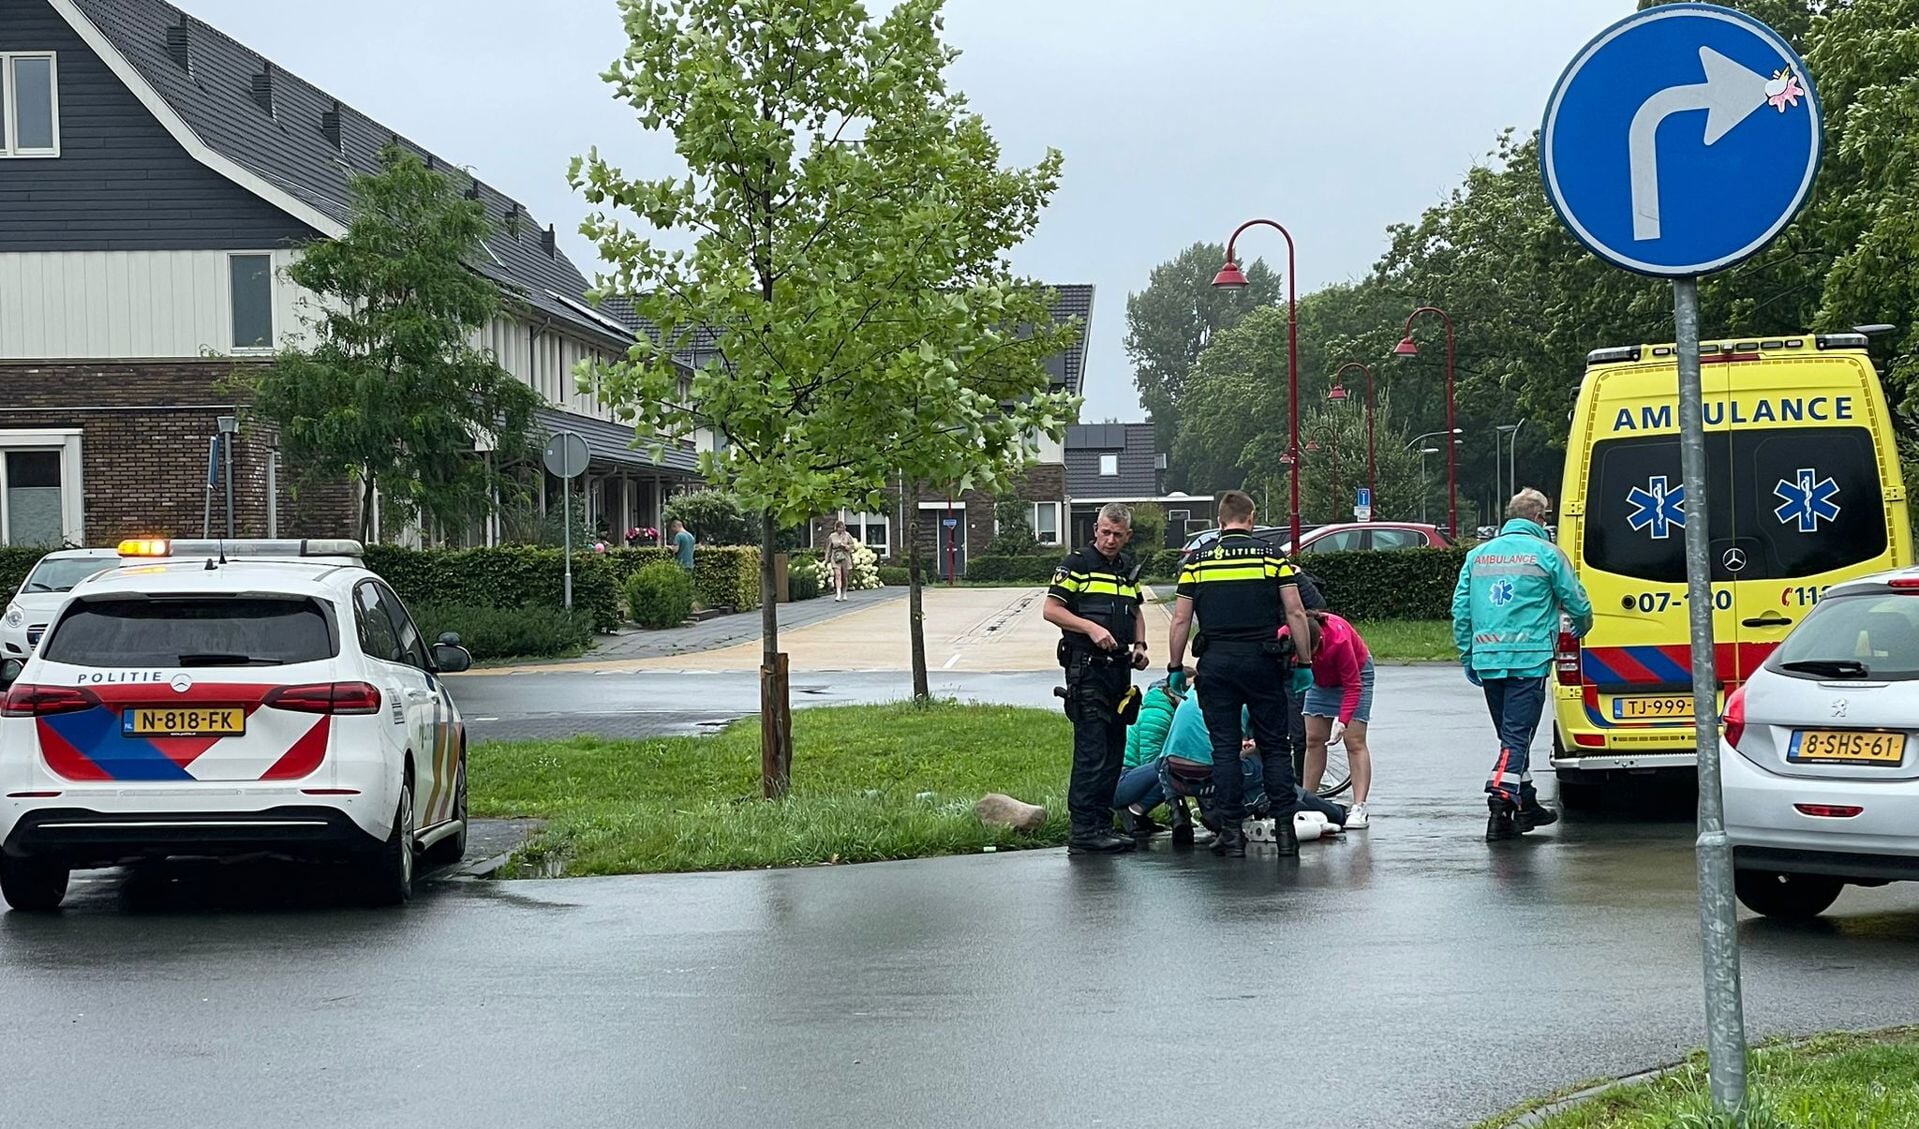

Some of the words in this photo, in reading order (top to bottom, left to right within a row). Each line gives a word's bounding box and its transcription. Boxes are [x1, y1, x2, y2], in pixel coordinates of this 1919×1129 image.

[1613, 397, 1853, 431] AMULANCE
[1474, 554, 1536, 564] AMBULANCE
[1639, 590, 1732, 612] 07-0
[77, 672, 162, 684] POLITIE
[1628, 699, 1695, 714] TJ-999-
[142, 711, 233, 730] N-818-FK
[1806, 734, 1893, 757] 8-SHS-61
